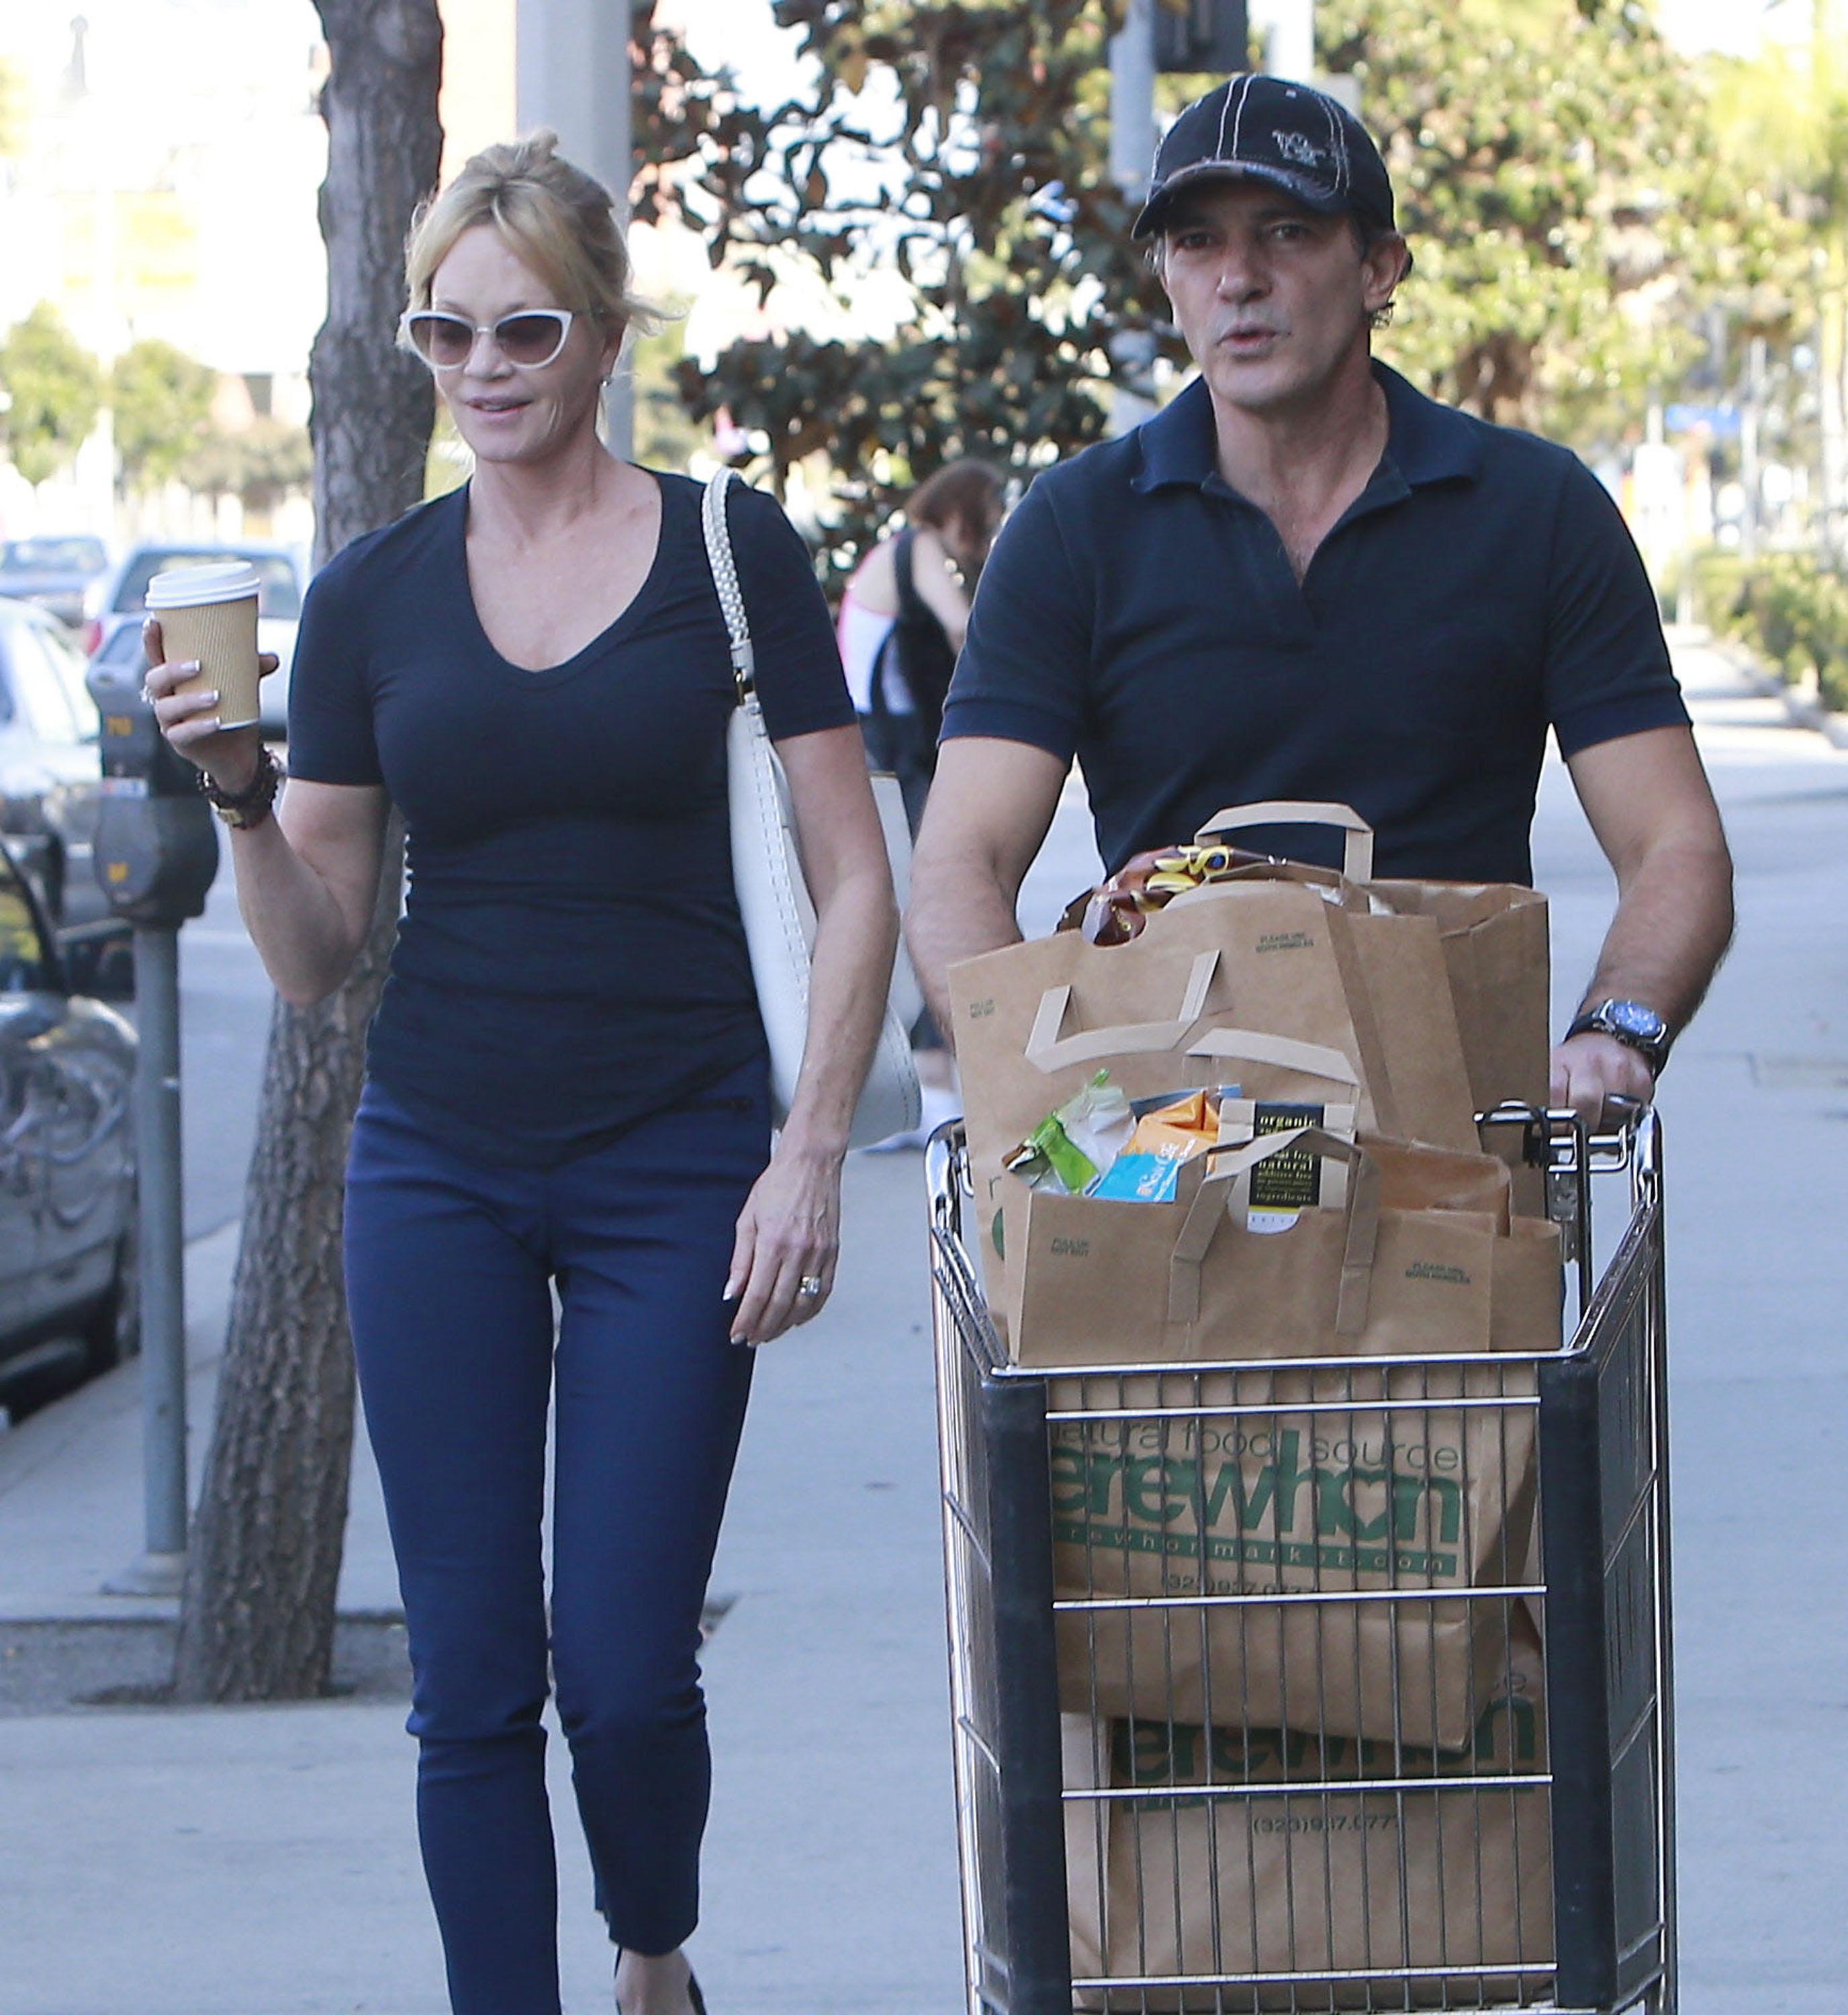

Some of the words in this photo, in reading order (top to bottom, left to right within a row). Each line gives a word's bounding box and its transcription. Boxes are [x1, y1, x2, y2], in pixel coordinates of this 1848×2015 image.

[1260, 1115, 1316, 1130] organic
[1258, 1161, 1313, 1171] natural
[1052, 1419, 1170, 1449] atural
[1309, 1437, 1459, 1471] source
[1052, 1429, 1459, 1545] erewhon
[1069, 1527, 1442, 1572] rewhonmarkt.com
